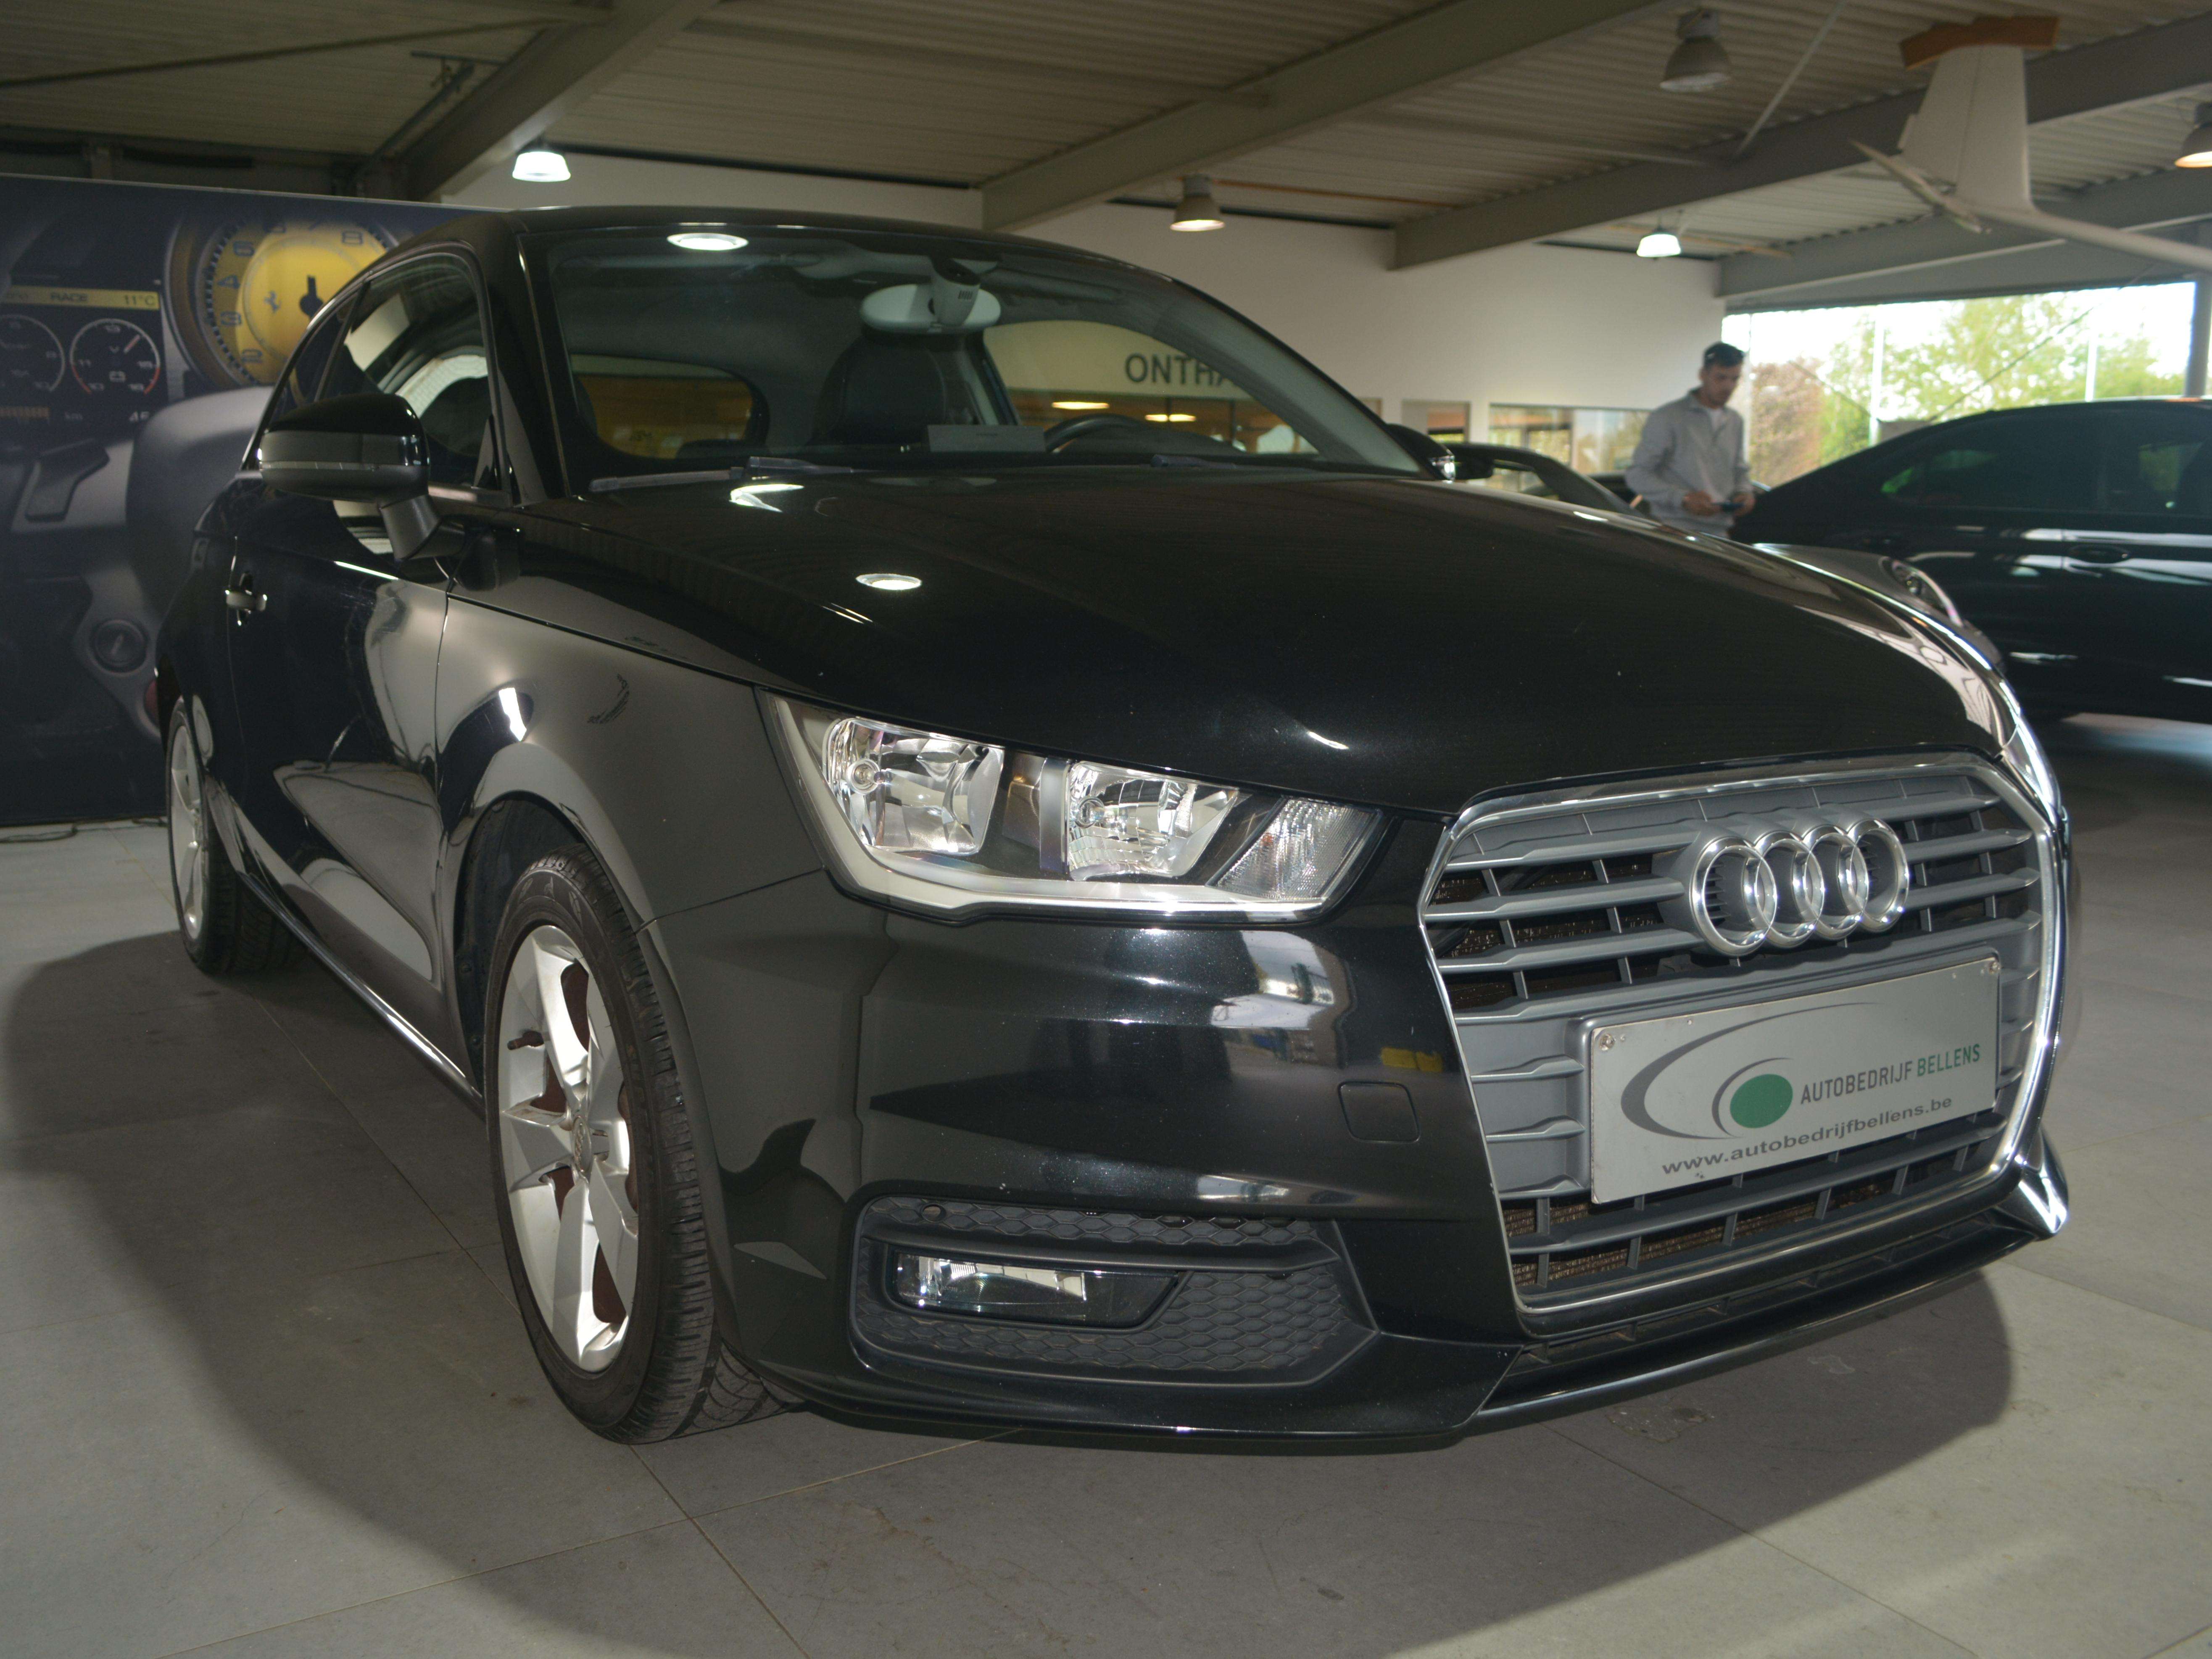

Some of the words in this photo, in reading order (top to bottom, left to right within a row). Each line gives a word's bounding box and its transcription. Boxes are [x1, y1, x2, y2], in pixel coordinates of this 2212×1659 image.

[218, 274, 240, 289] 4
[50, 292, 88, 303] RACE
[220, 311, 242, 326] 3
[241, 348, 263, 364] 2
[1800, 1060, 1913, 1105] AUTOBEDRIJF
[1917, 1043, 1981, 1077] BELLENS
[1662, 1097, 1952, 1175] www.autobedrijfbellens.be
